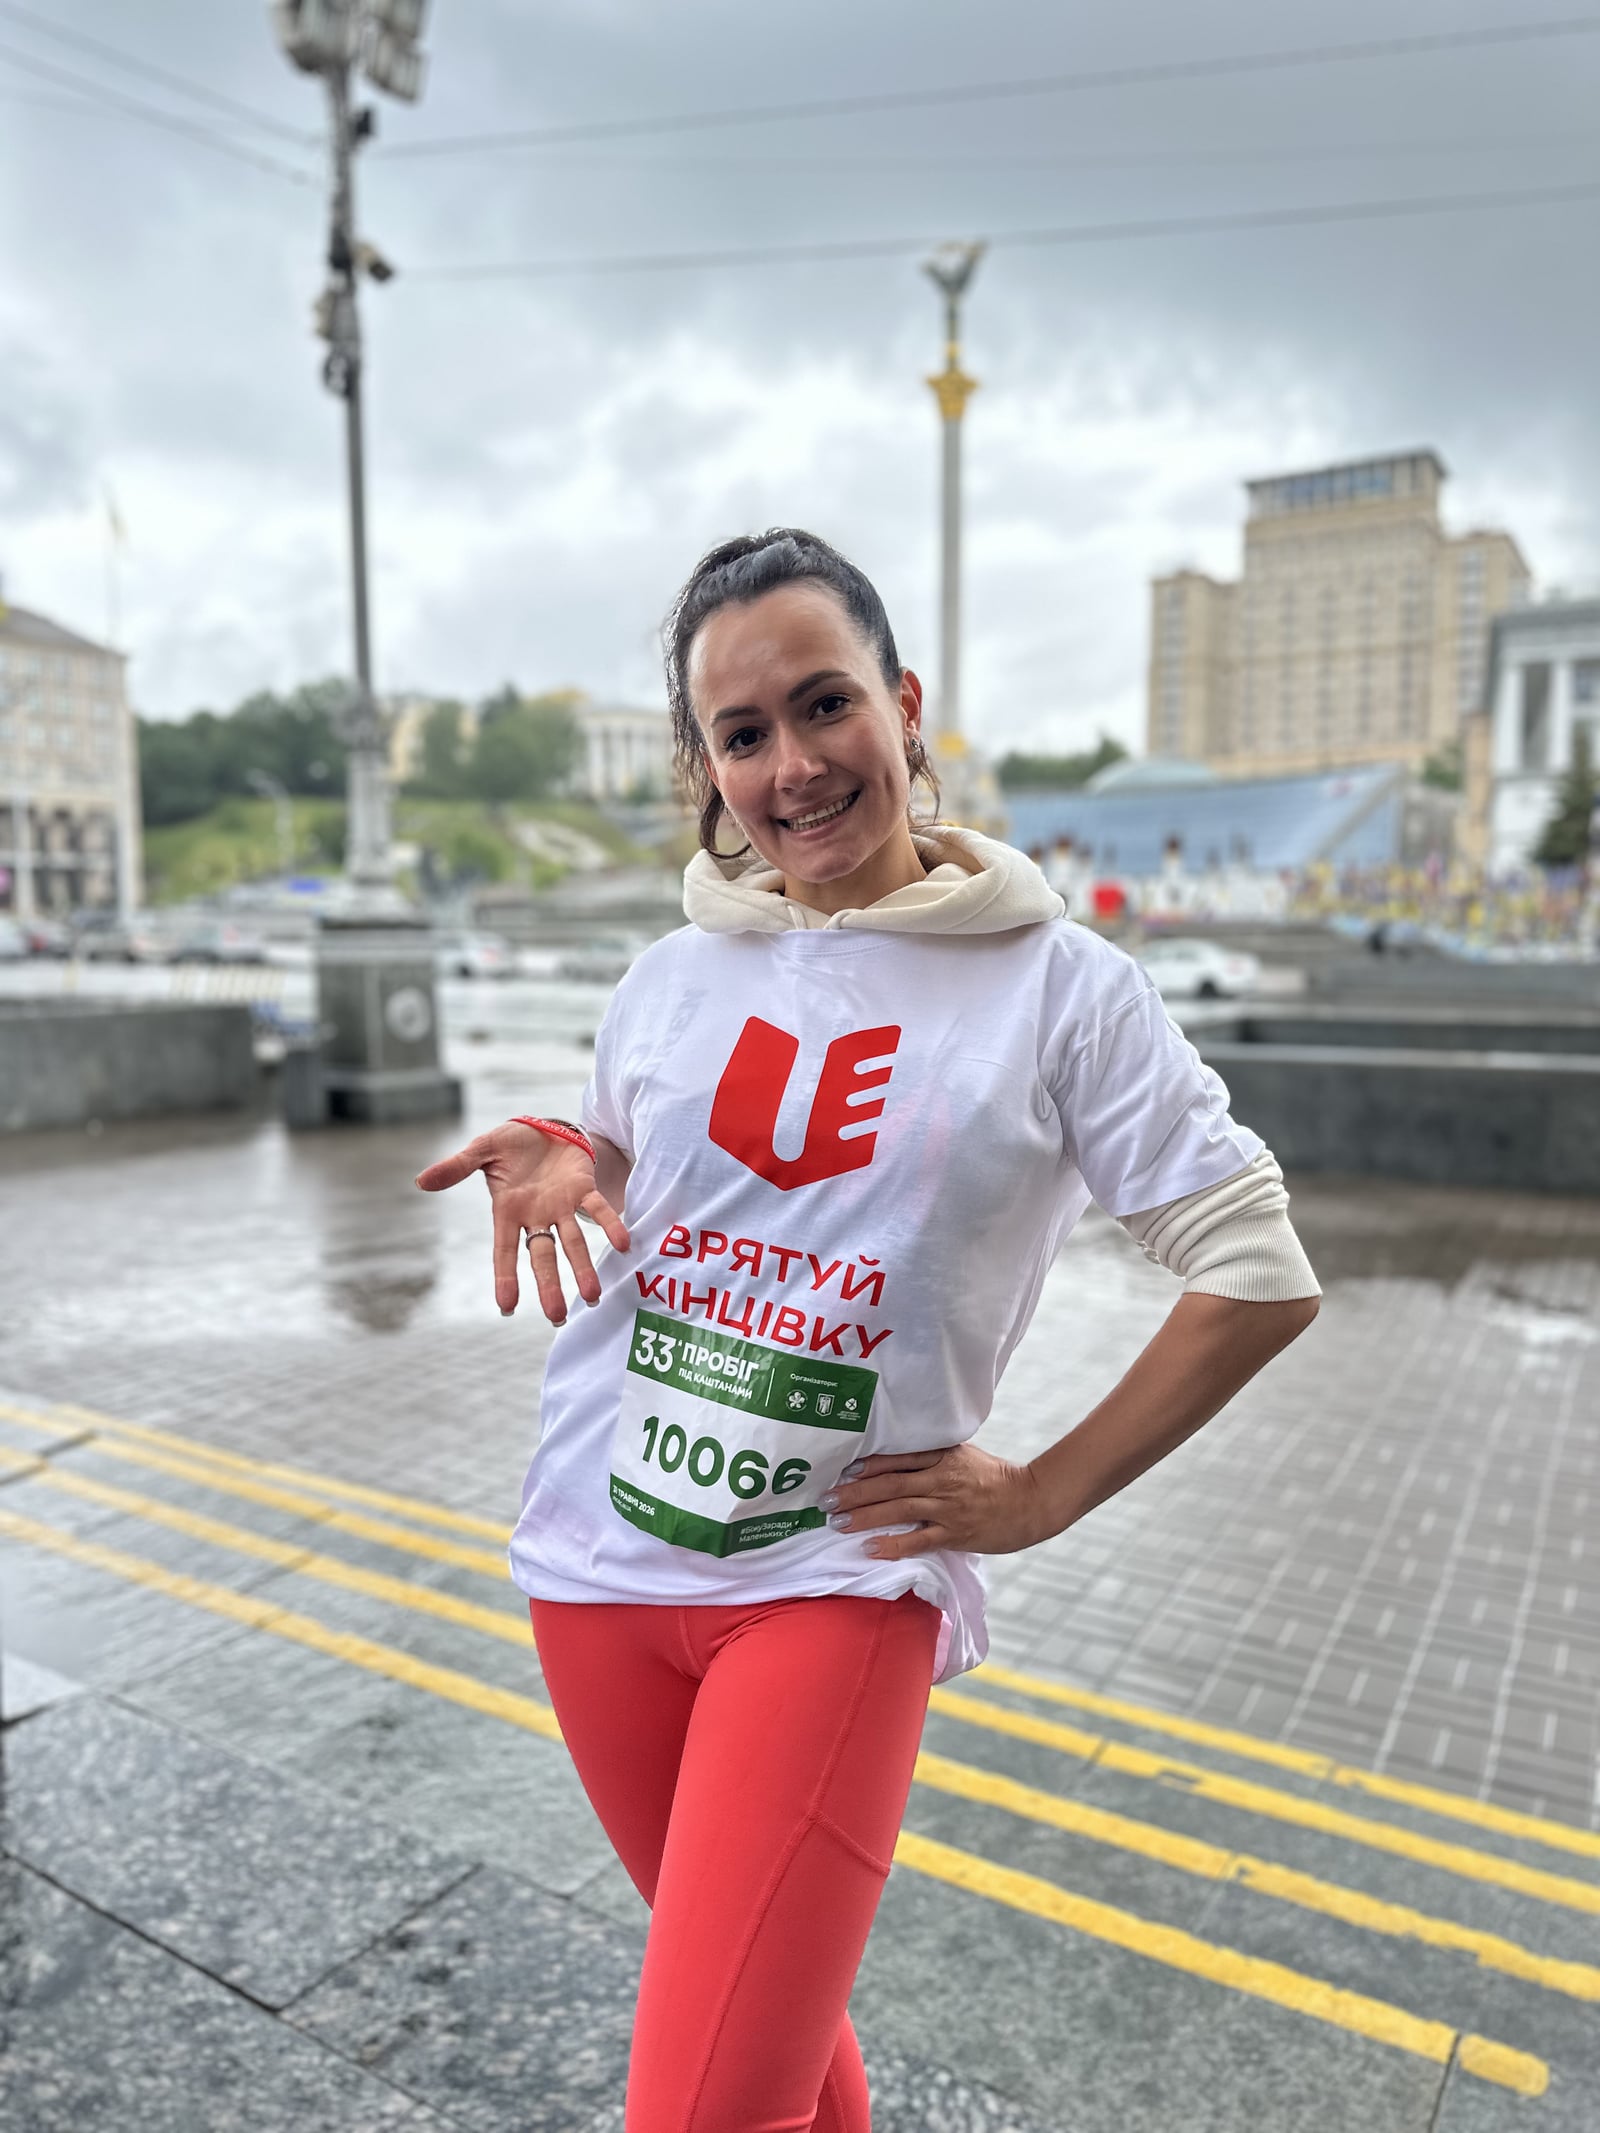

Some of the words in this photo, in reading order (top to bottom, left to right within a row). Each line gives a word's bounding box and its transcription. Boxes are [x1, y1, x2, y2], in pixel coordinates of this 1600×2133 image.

[659, 1224, 886, 1306] ВРЯТУЙ
[635, 1271, 894, 1359] КІНЦІВКУ
[678, 1367, 693, 1383] ПІД
[693, 1372, 753, 1400] КАШТАНАМИ
[681, 1342, 759, 1382] ПРОБІГ
[642, 1416, 812, 1500] 10066
